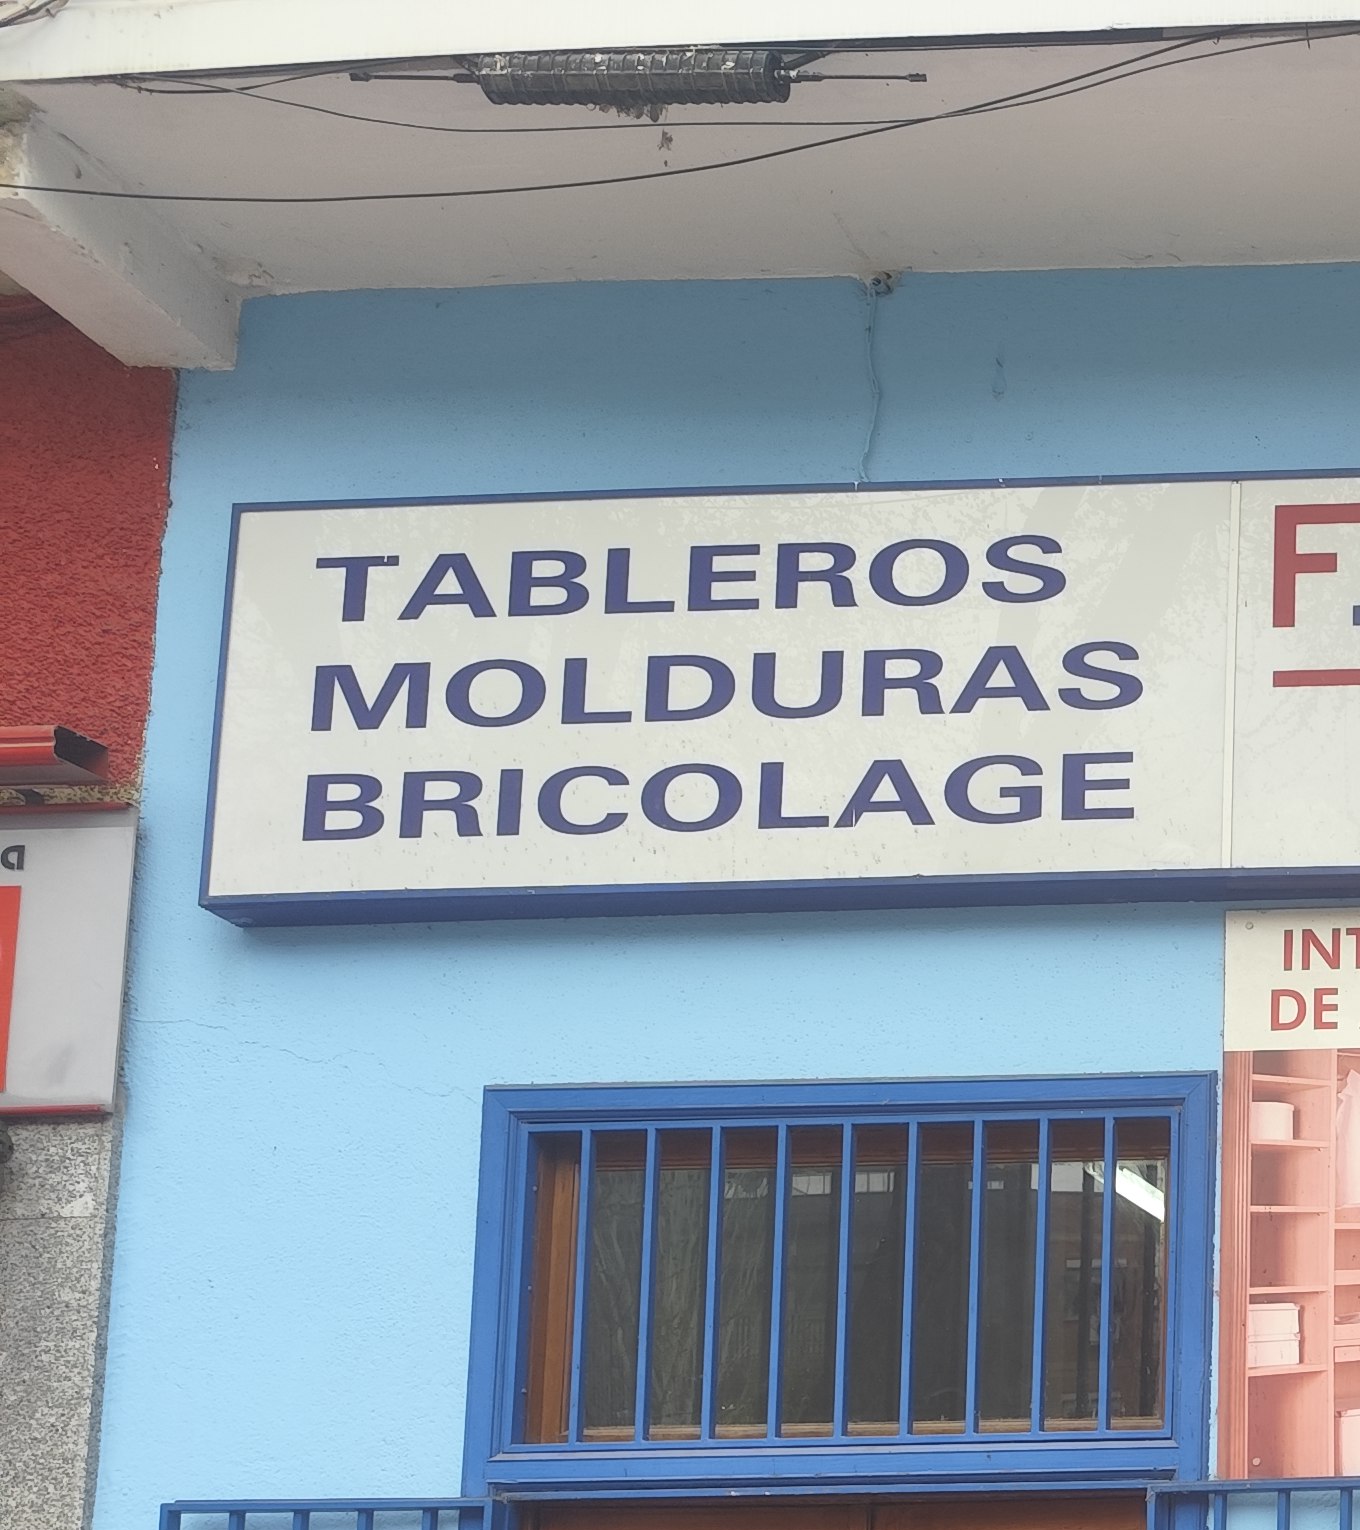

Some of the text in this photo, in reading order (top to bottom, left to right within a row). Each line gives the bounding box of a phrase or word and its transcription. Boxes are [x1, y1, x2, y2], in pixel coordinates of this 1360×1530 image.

[316, 534, 1066, 622] TABLEROS
[310, 641, 1144, 731] MOLDURAS
[301, 751, 1133, 842] BRICOLAGE
[1270, 987, 1340, 1032] DE
